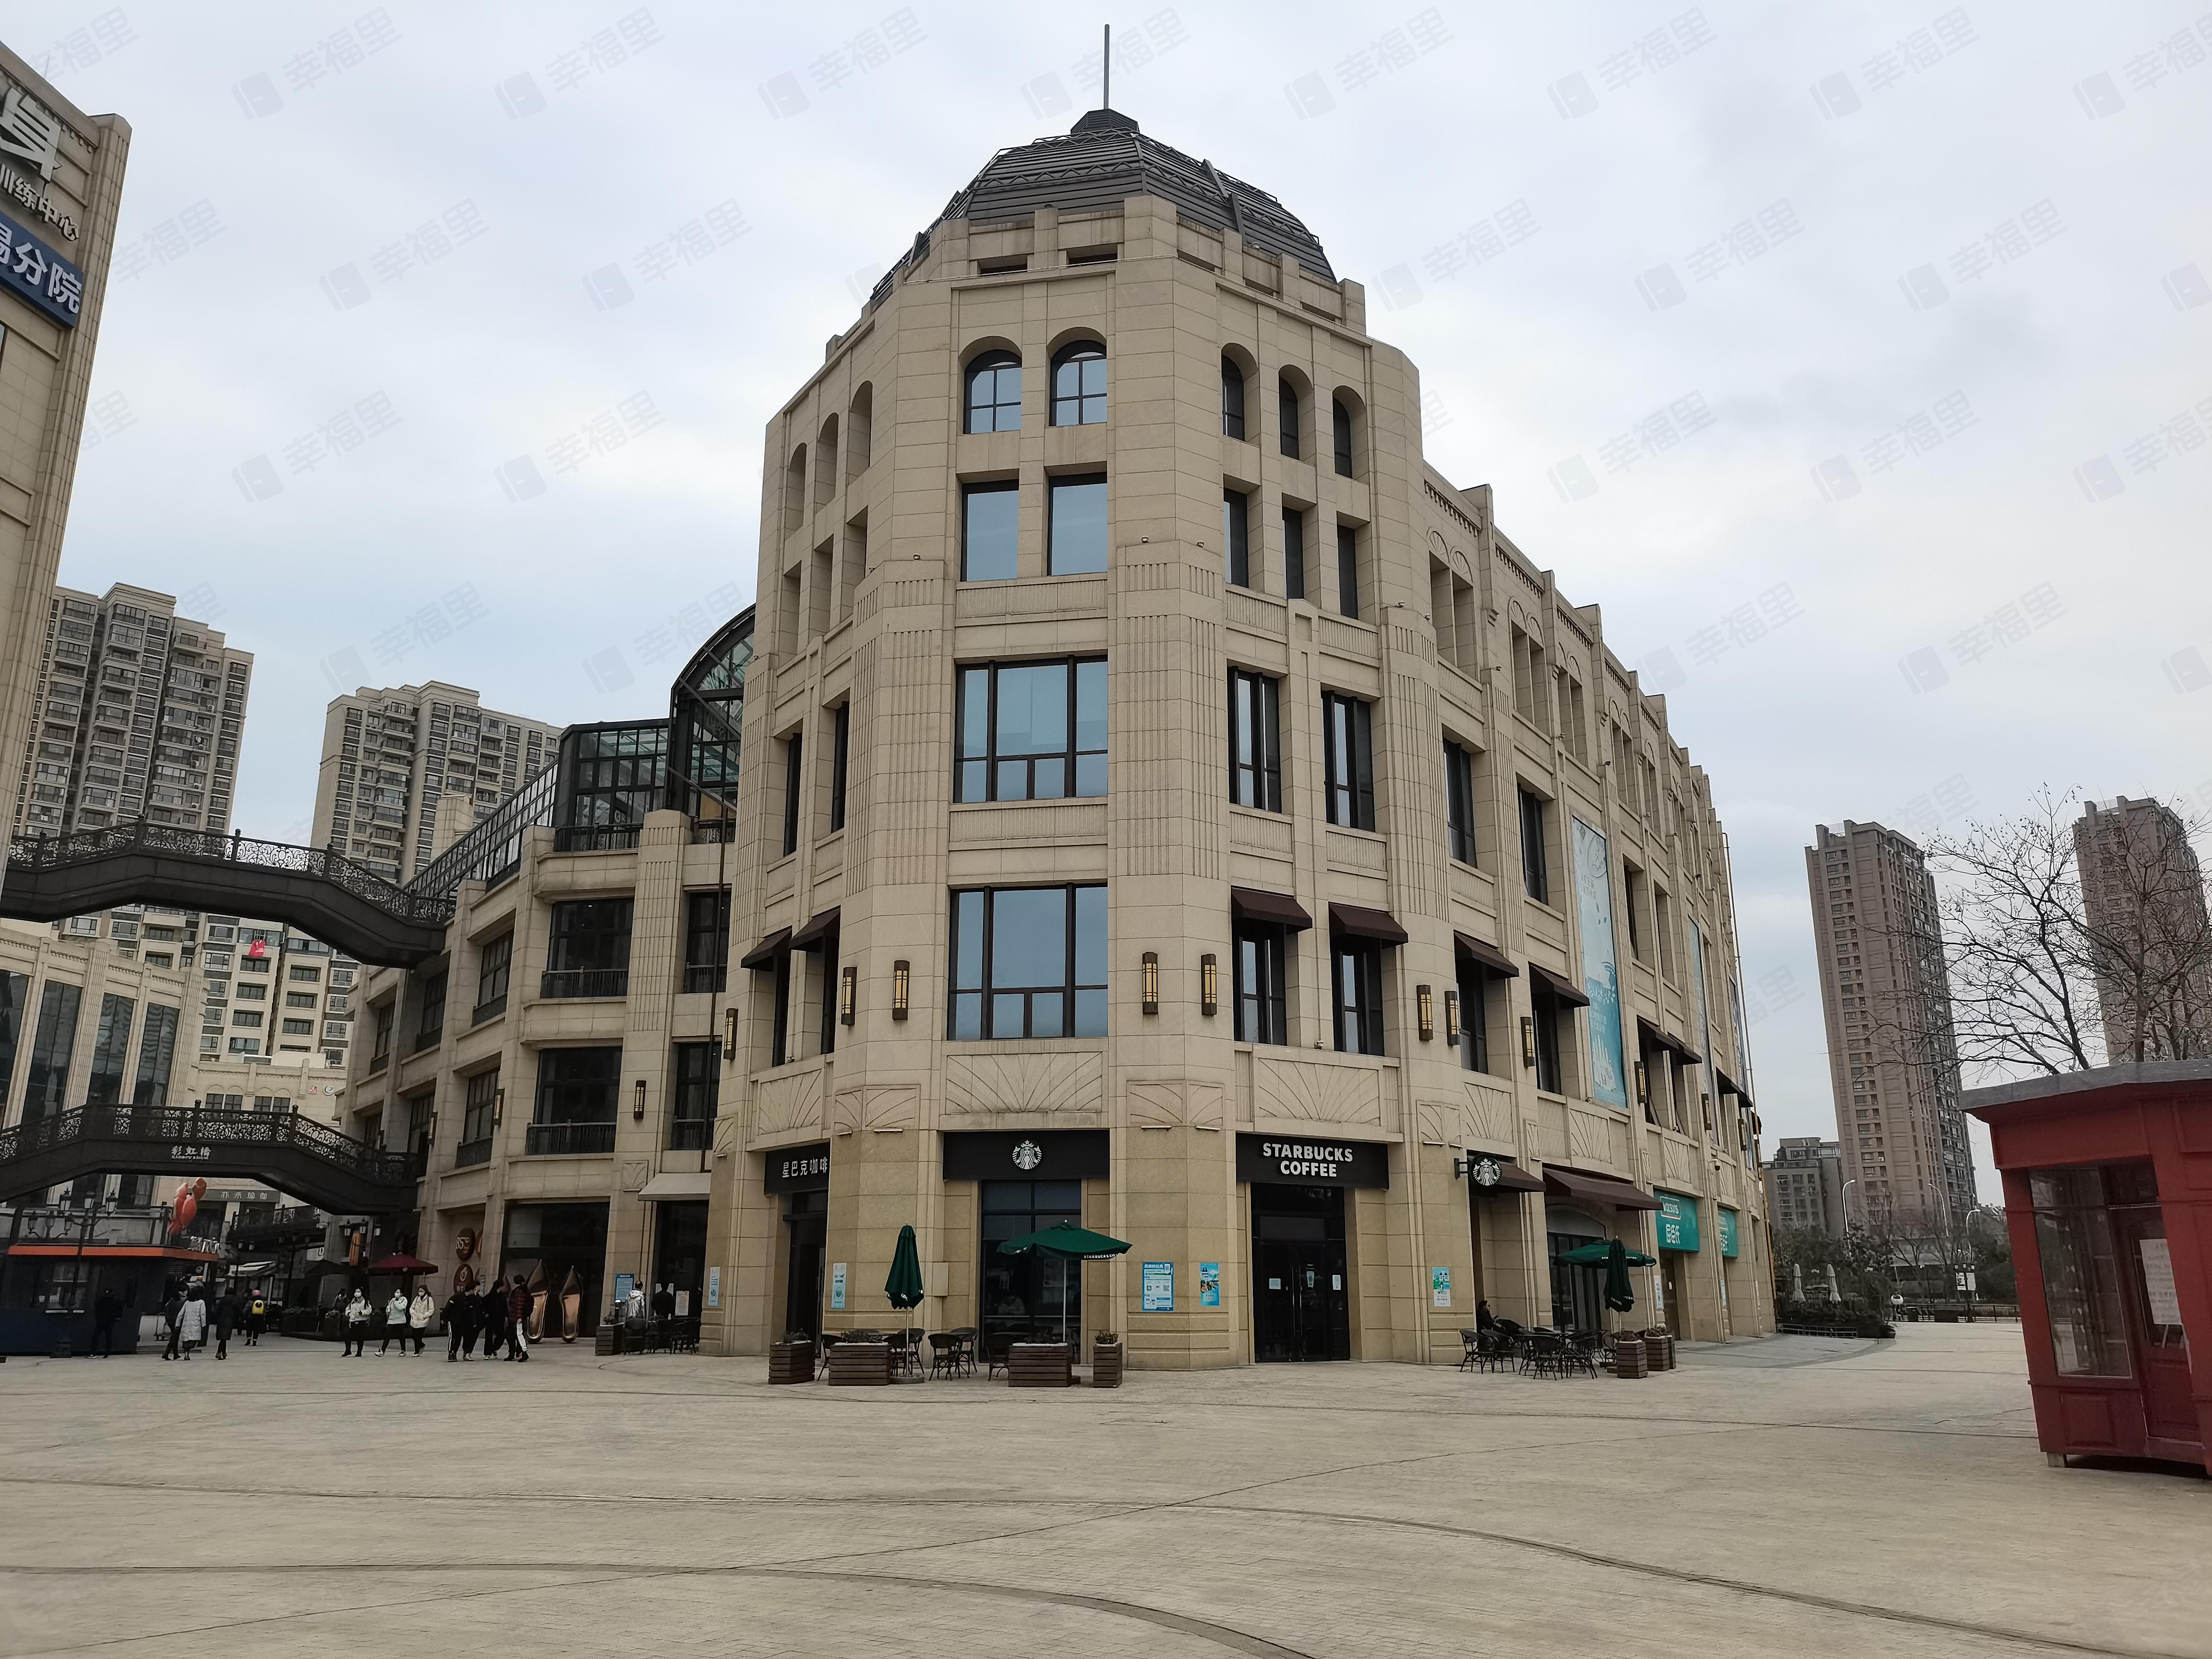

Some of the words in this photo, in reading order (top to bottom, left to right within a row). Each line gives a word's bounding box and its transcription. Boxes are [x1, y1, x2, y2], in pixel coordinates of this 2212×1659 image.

[171, 1145, 211, 1156] 彩虹桥
[1263, 1142, 1353, 1162] STARBUCKS
[782, 1156, 828, 1178] 星巴克咖啡
[1280, 1160, 1337, 1177] COFFEE
